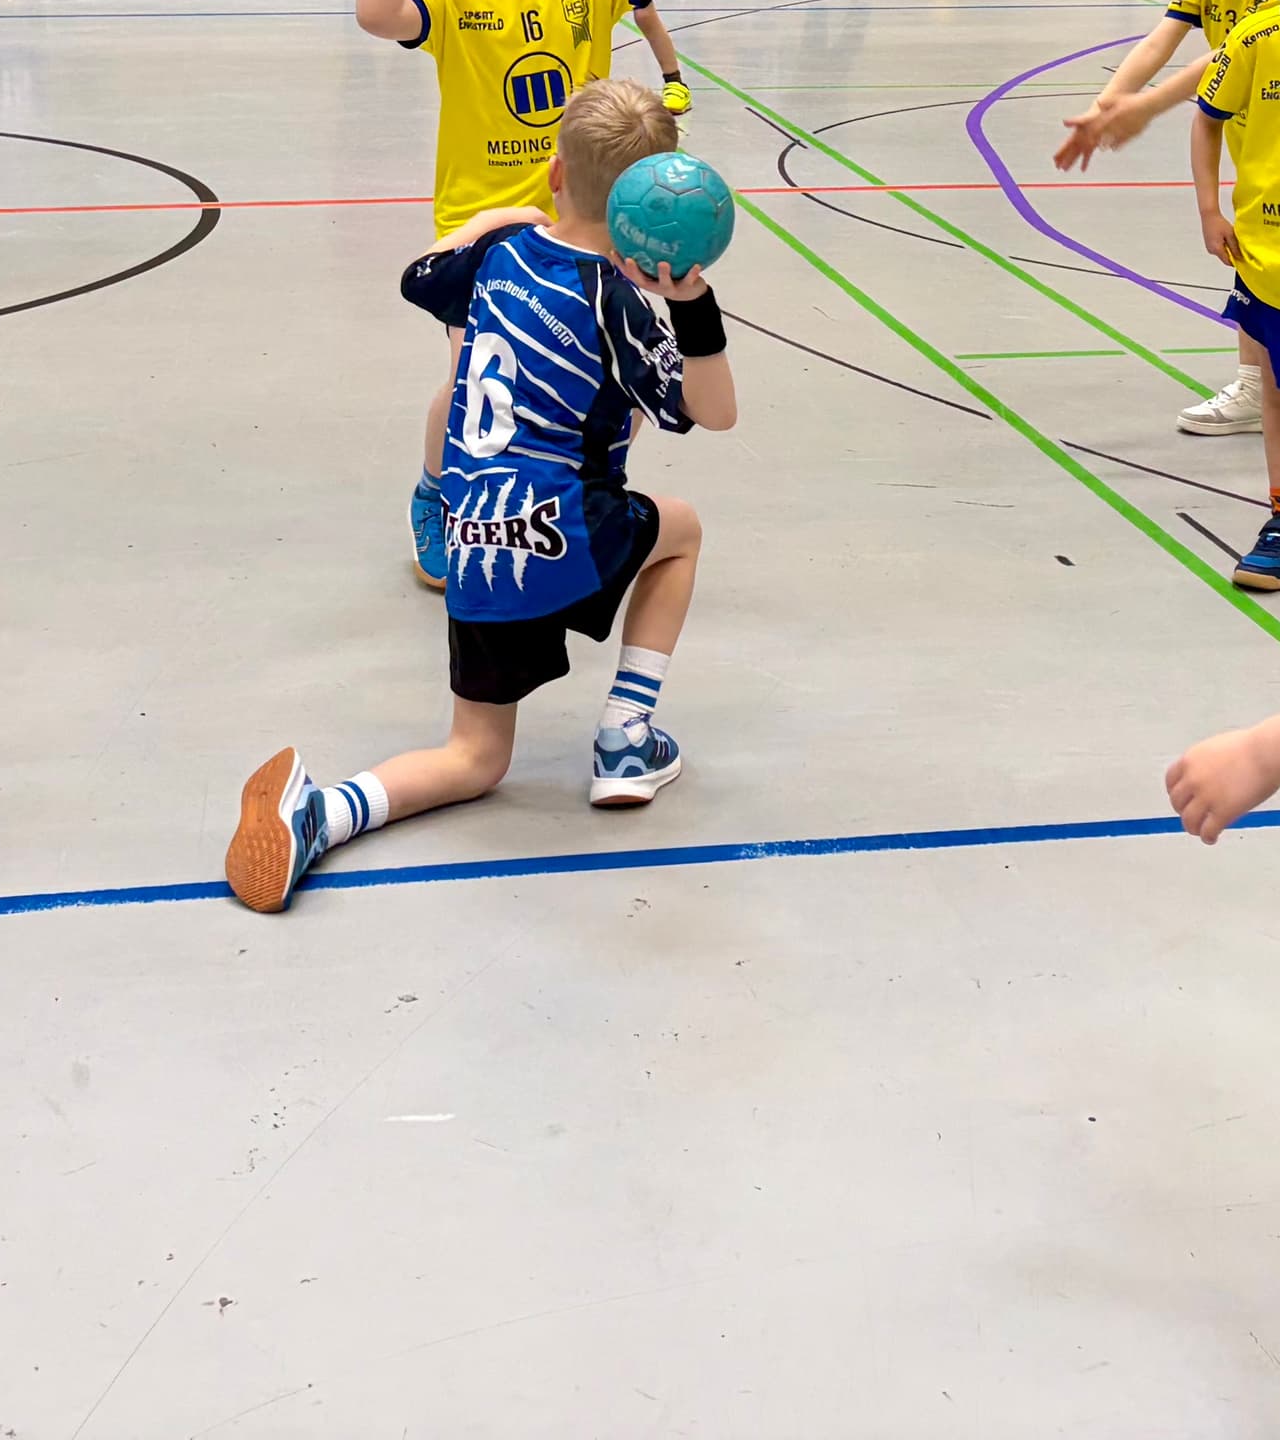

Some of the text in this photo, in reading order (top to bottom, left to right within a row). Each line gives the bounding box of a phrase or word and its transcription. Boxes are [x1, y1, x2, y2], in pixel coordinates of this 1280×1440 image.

[521, 9, 544, 43] 16
[487, 136, 552, 155] MEDING
[463, 332, 518, 458] 6
